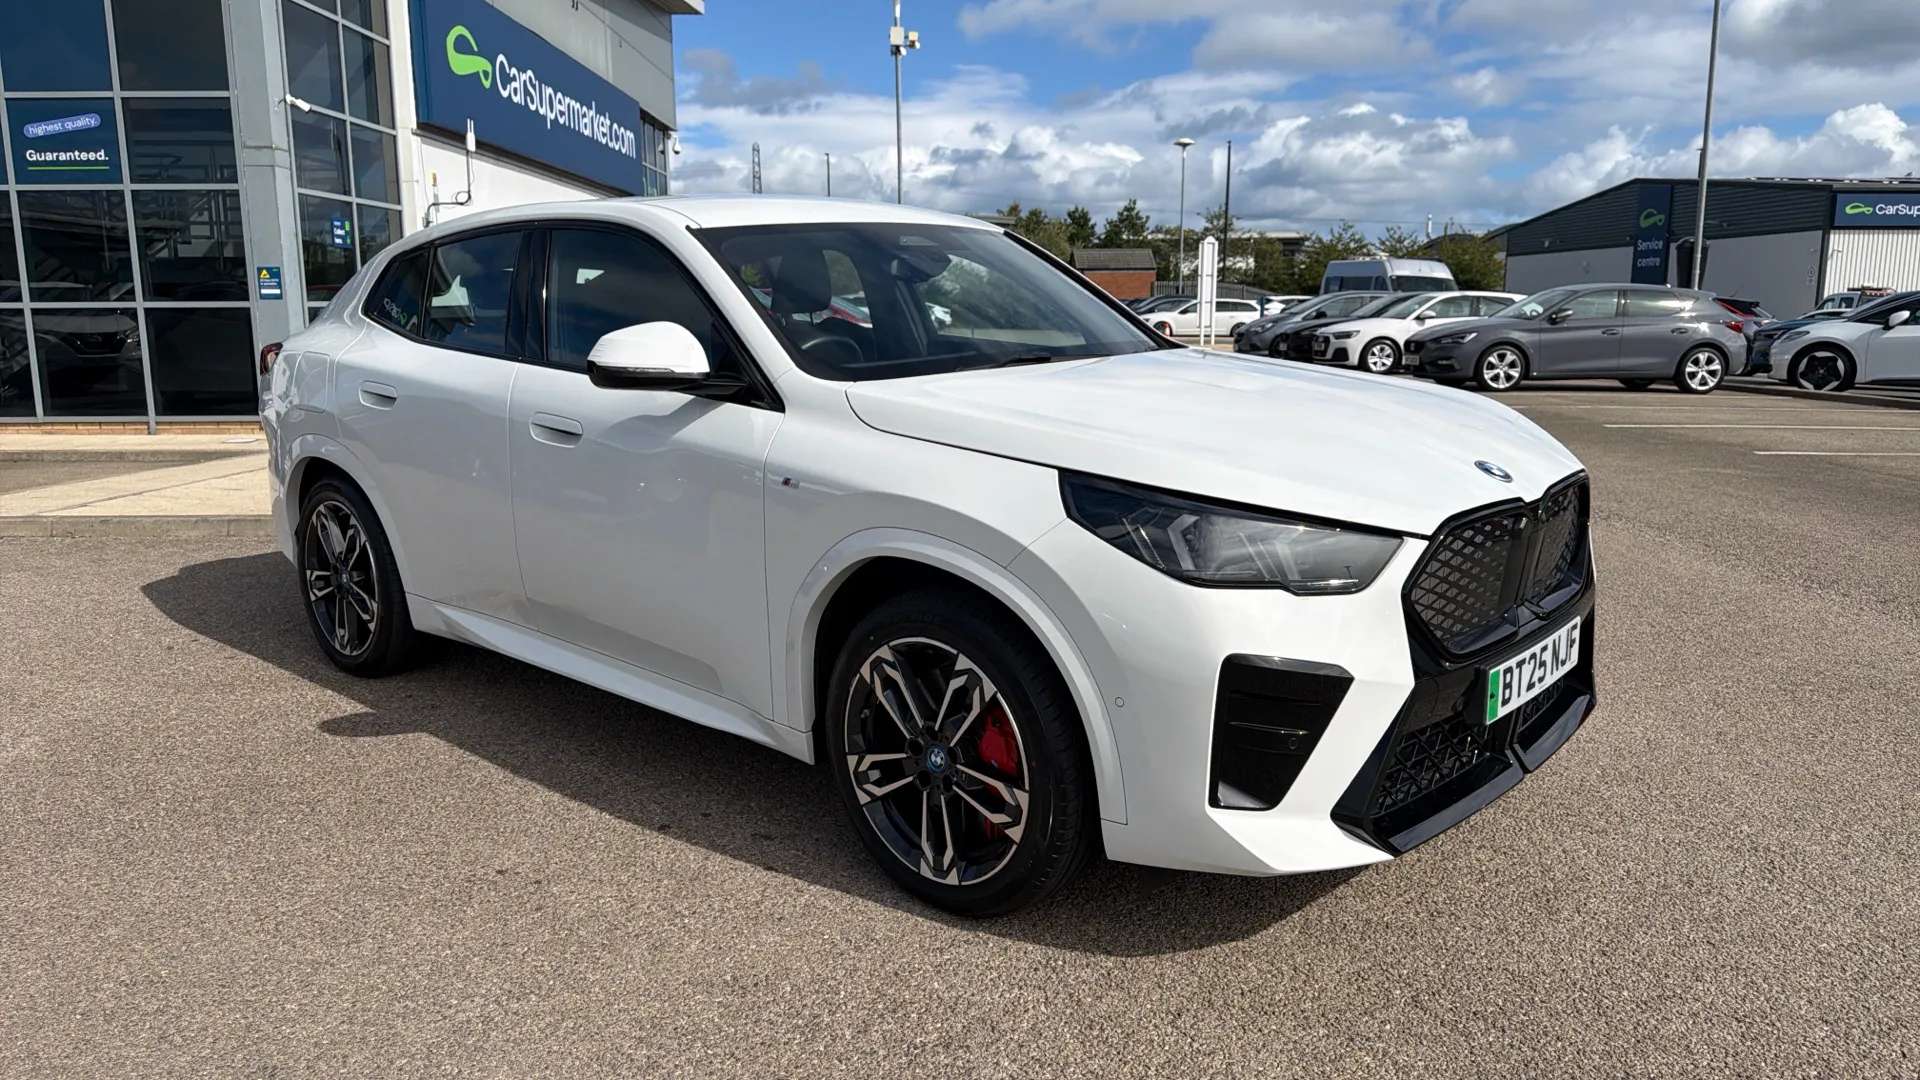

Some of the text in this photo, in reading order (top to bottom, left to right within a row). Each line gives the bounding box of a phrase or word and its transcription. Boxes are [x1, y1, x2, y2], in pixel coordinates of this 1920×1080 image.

[495, 53, 636, 159] CarSupermarket.com
[28, 122, 62, 136] highest
[26, 149, 109, 161] Guaranteed.
[1637, 238, 1663, 251] Service
[1637, 257, 1661, 267] centre
[1501, 623, 1579, 708] BT25 NJF
